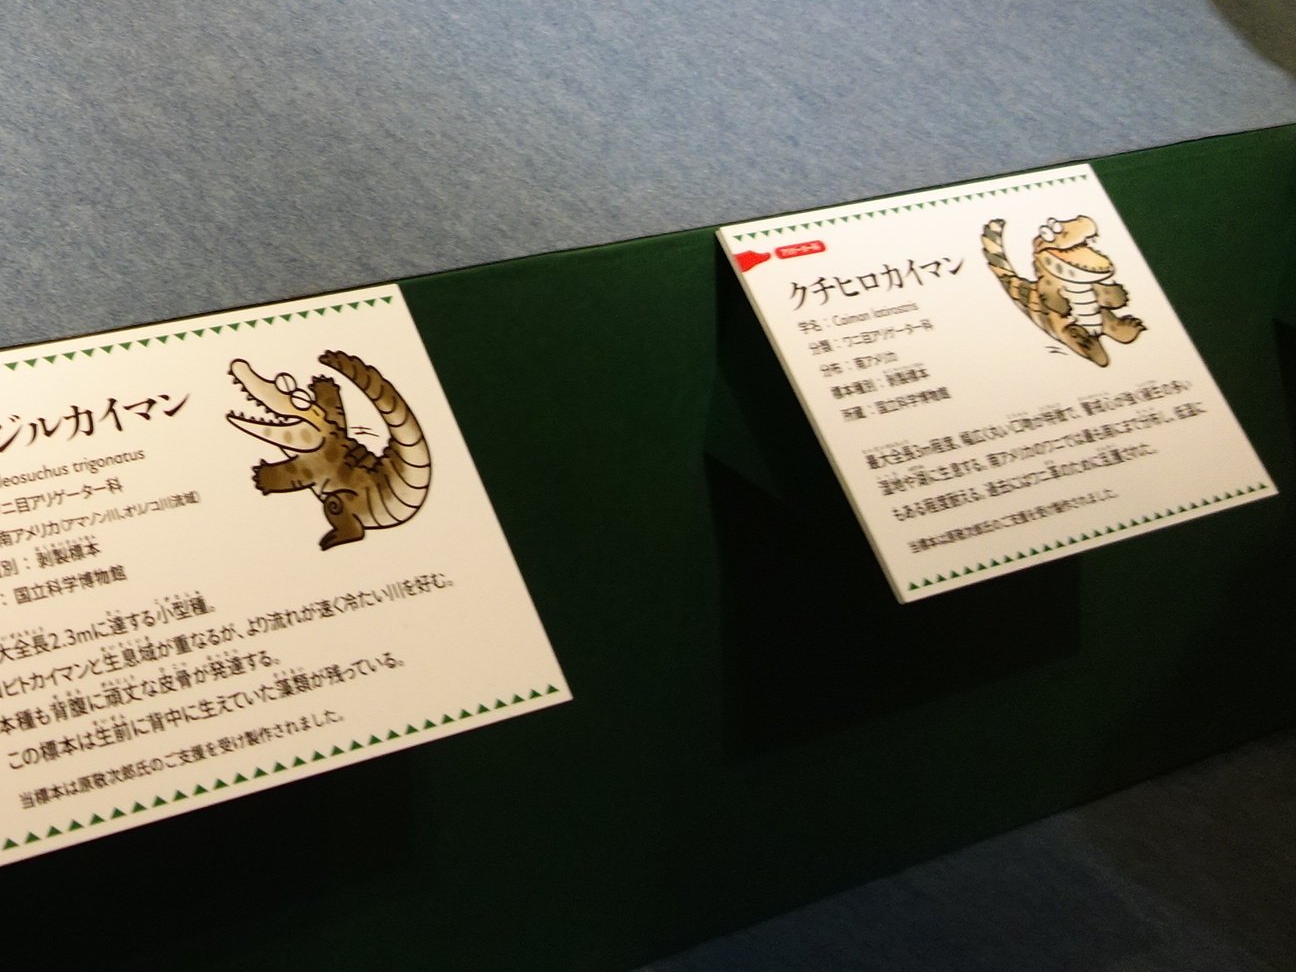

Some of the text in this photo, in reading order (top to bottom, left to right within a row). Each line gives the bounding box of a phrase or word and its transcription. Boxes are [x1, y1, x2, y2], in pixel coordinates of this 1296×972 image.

[789, 257, 965, 311] クチヒロカイマン
[73, 448, 146, 474] trigonatus
